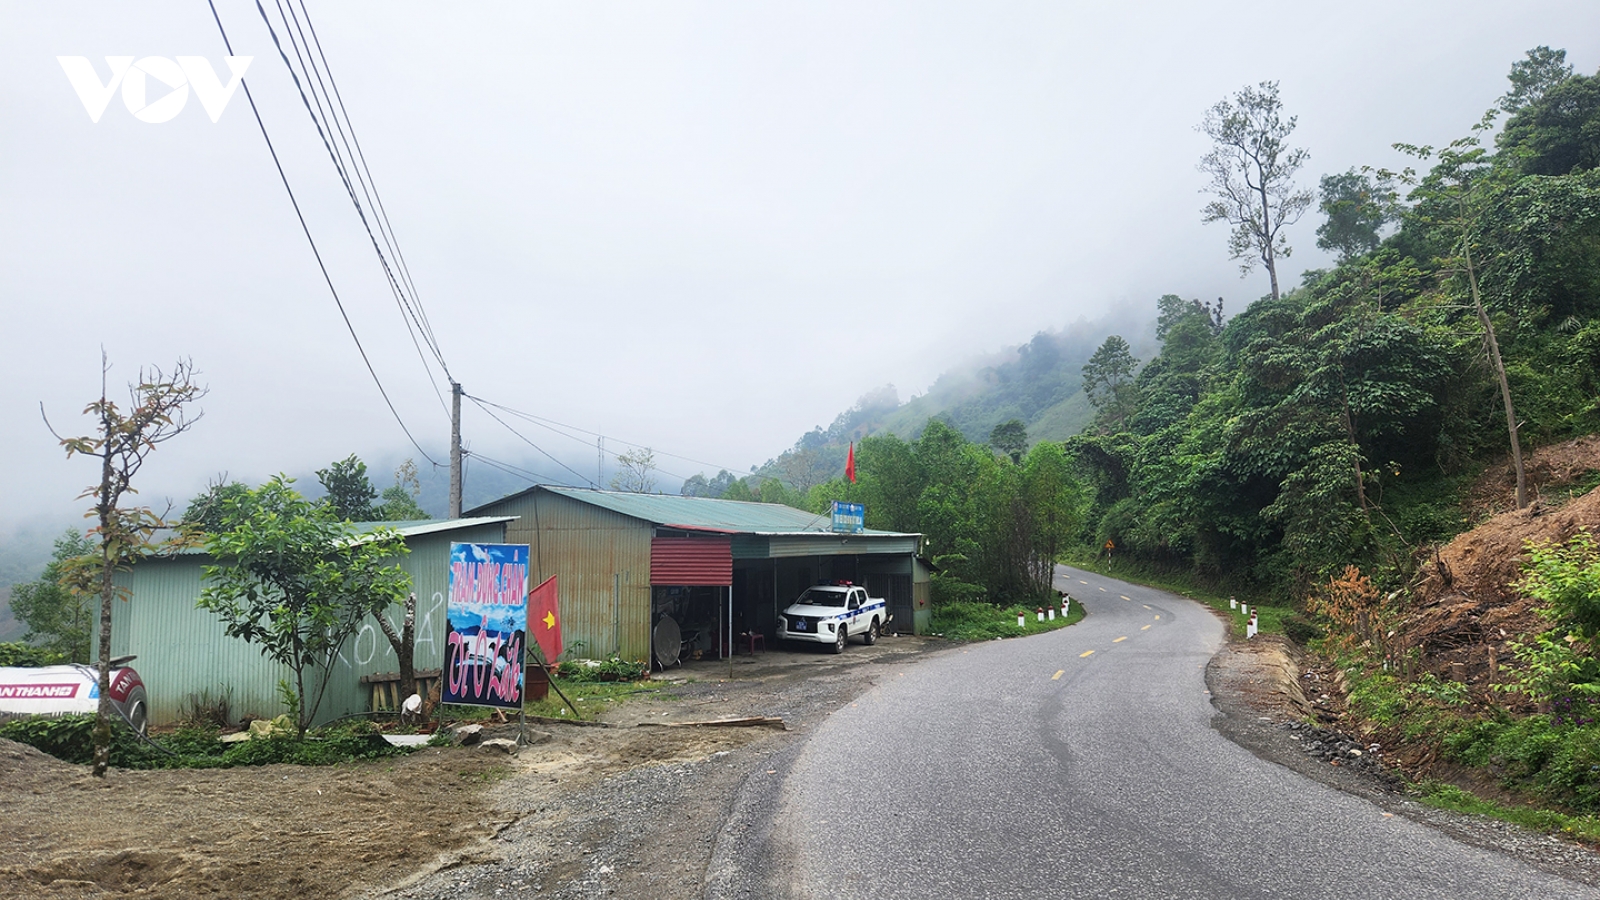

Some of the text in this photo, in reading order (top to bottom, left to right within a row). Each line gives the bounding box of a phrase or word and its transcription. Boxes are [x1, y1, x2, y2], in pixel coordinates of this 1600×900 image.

[452, 562, 475, 616] TRẠM
[501, 549, 525, 605] CHÂN
[15, 686, 61, 697] THANH
